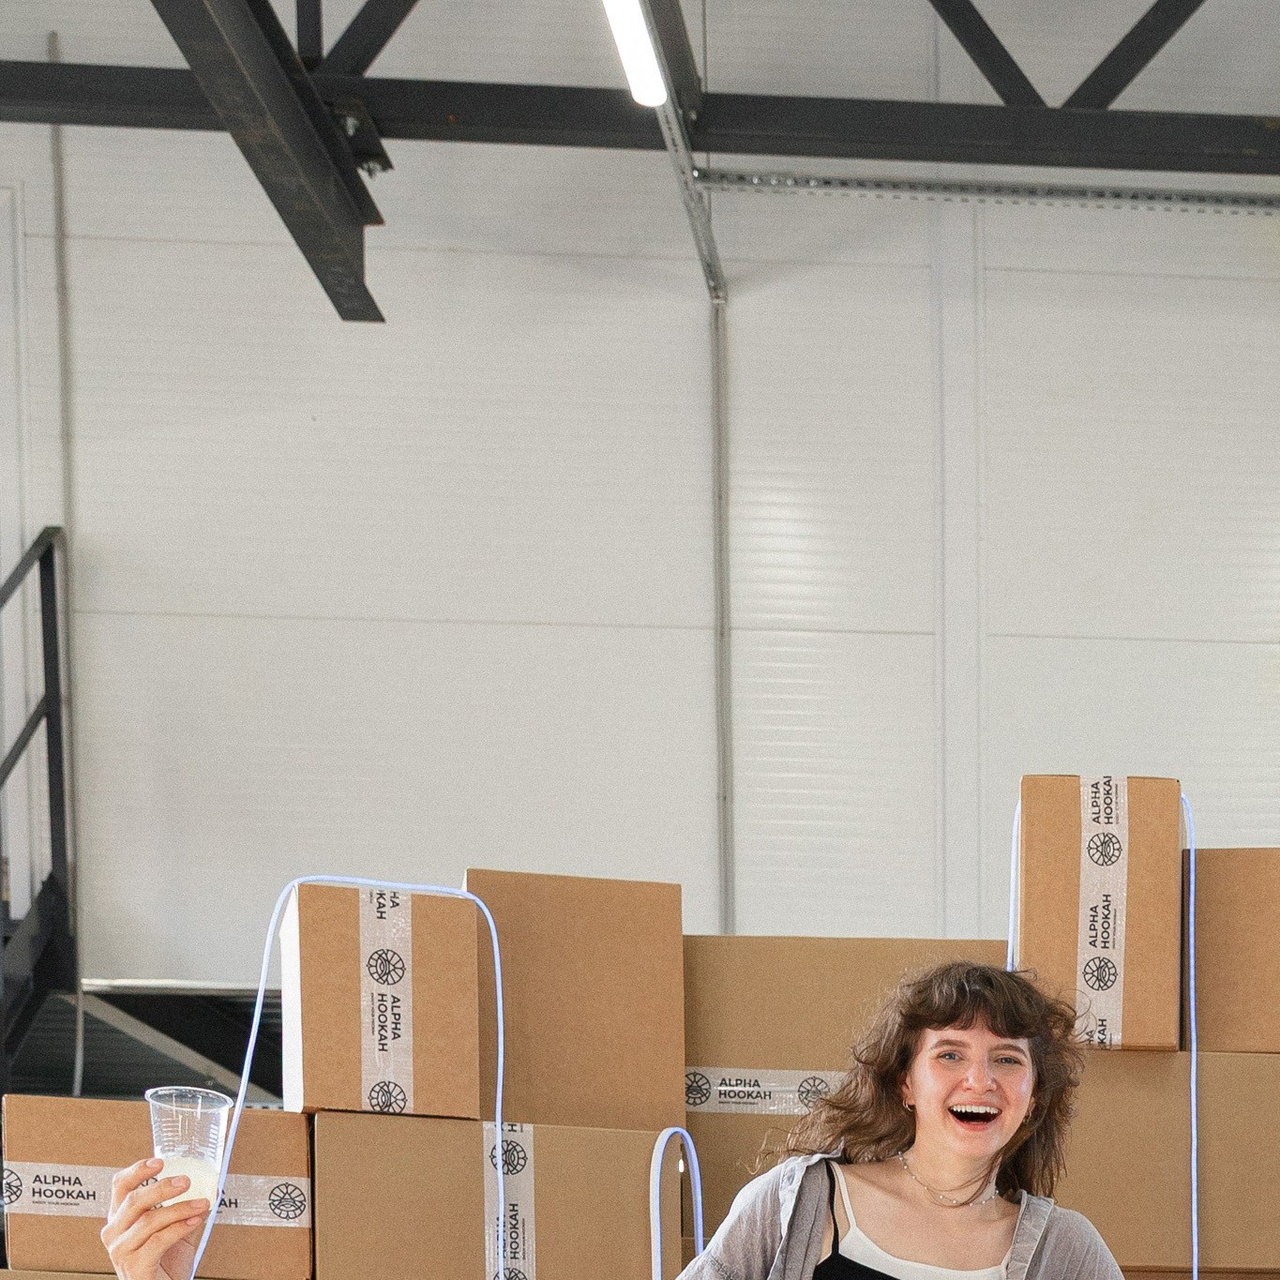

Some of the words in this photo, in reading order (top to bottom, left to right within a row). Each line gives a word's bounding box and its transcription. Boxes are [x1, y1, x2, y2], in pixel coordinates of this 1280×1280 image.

[1092, 781, 1101, 825] ALPHA
[1089, 904, 1099, 949] ALPHA
[1101, 894, 1112, 950] HOOKAH
[378, 993, 389, 1053] HOOKAH
[391, 995, 402, 1041] ALPHA
[718, 1090, 772, 1101] HOOKAH
[719, 1078, 762, 1089] ALPHA
[32, 1174, 83, 1187] ALPHA
[32, 1187, 97, 1201] HOOKAH
[510, 1203, 519, 1260] HOOKAH
